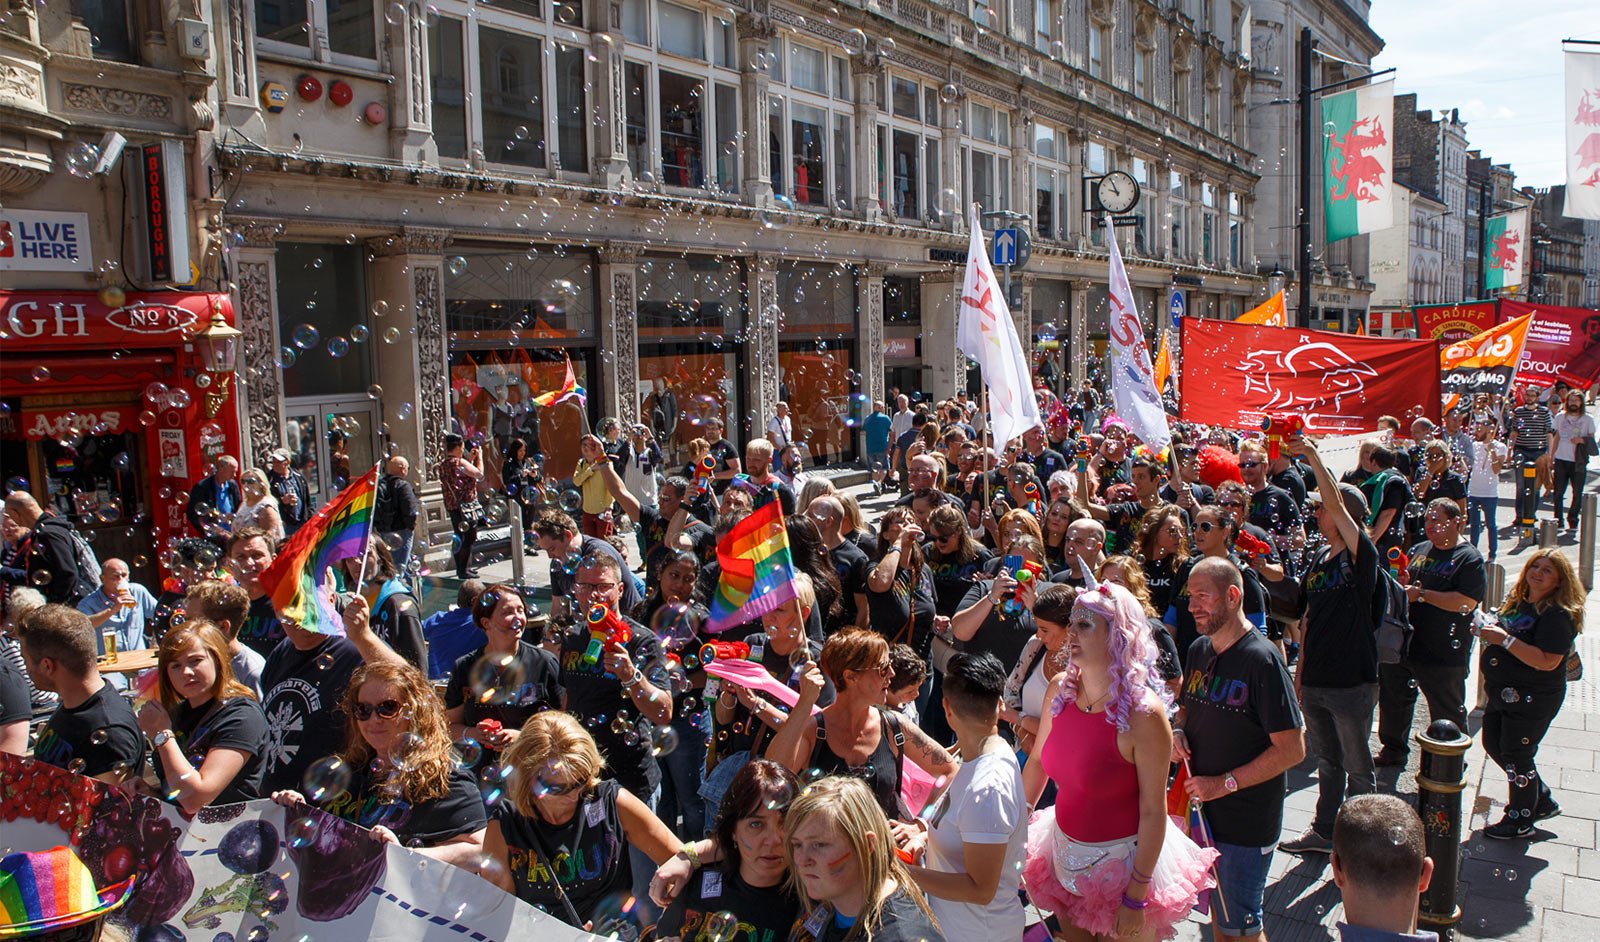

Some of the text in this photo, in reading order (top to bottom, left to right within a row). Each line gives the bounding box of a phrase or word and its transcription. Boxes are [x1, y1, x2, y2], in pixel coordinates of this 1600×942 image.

[147, 156, 164, 257] BOROUGH
[19, 221, 78, 242] LIVE
[21, 241, 79, 260] HERE
[167, 309, 179, 326] 8
[1423, 308, 1487, 324] CARDIFF
[1442, 320, 1466, 330] UNION
[161, 431, 181, 439] FRIDAY
